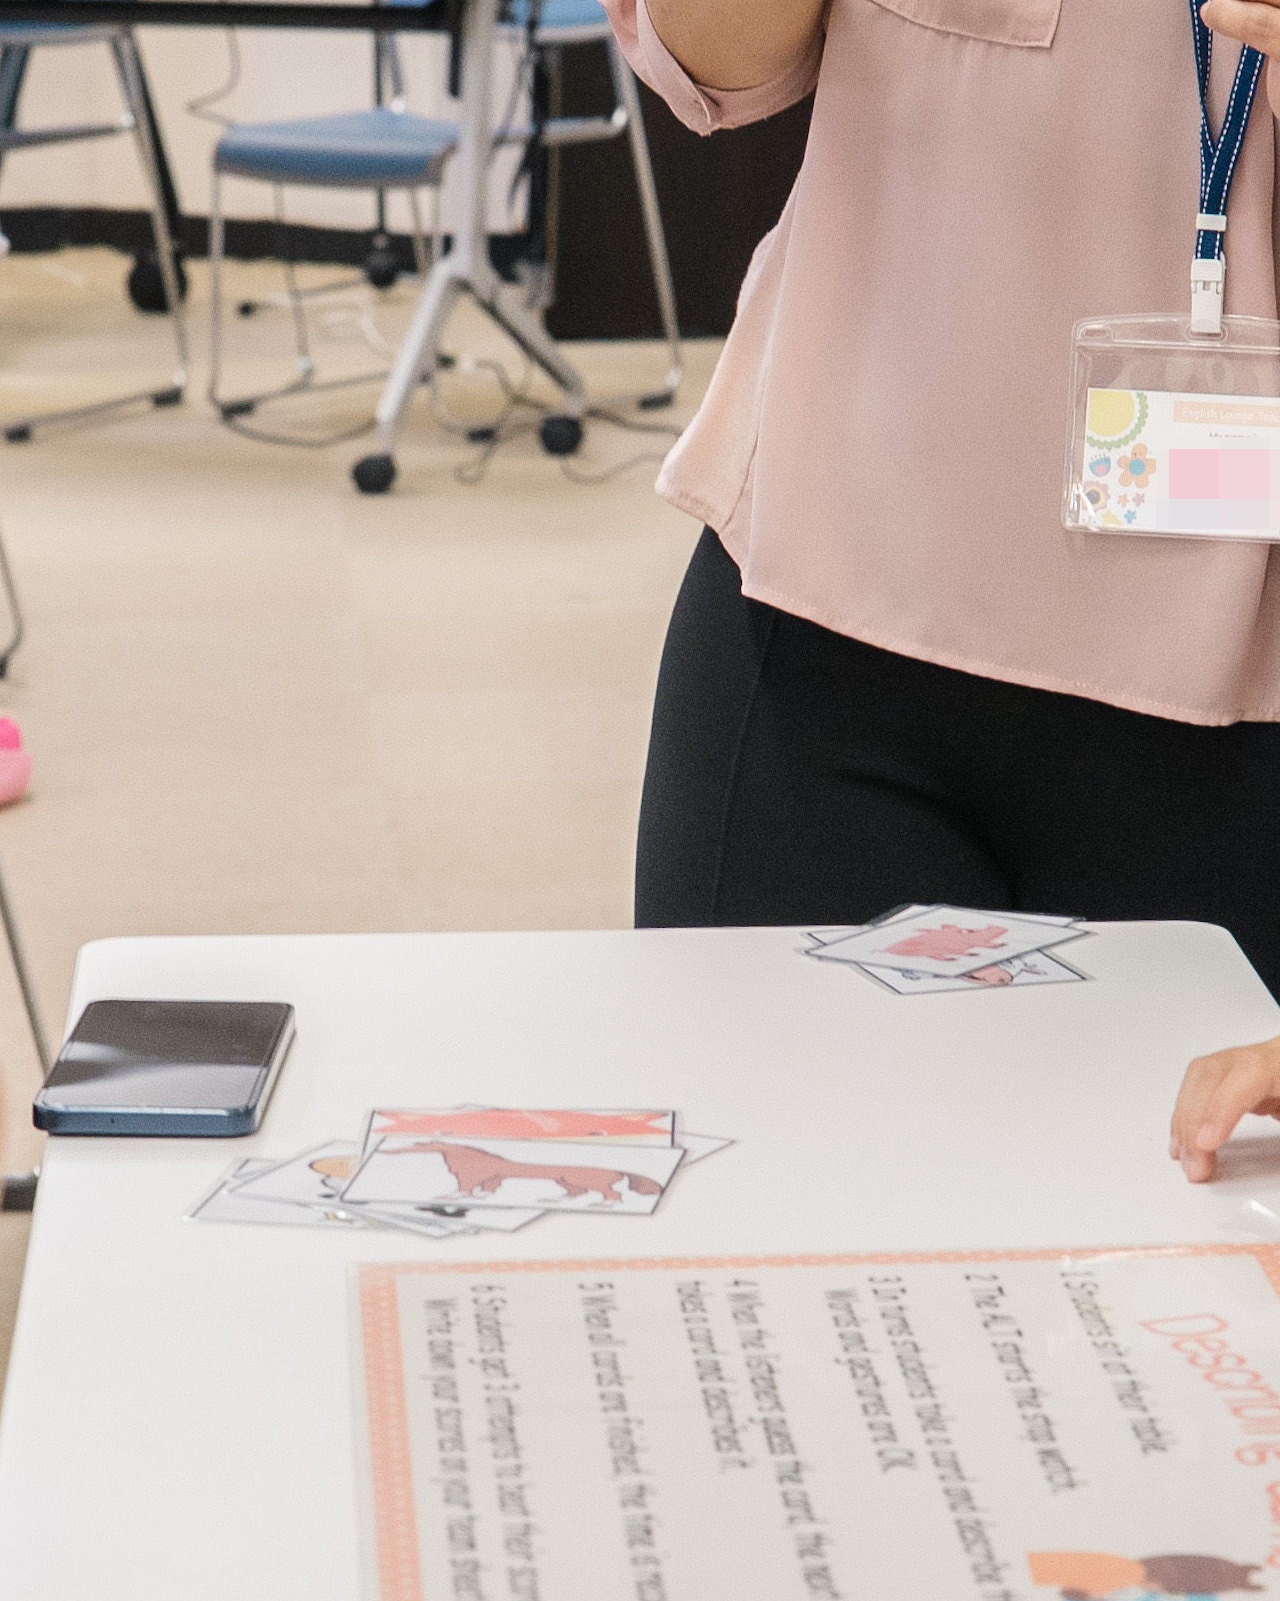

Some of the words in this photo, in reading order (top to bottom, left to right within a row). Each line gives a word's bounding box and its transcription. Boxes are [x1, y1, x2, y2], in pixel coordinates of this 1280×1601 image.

[1181, 406, 1217, 421] English
[1219, 409, 1254, 424] Lounge
[675, 1279, 712, 1315] takes
[726, 1290, 764, 1326] When
[824, 1288, 865, 1330] Words
[870, 1286, 908, 1302] In
[972, 1285, 1007, 1310] The
[1062, 1280, 1115, 1339] Students
[471, 1296, 510, 1355] Students
[581, 1293, 619, 1331] When
[878, 1303, 916, 1338] turns
[981, 1312, 1025, 1339] ALT
[586, 1331, 626, 1347] all
[685, 1326, 726, 1356] card
[738, 1327, 772, 1351] the
[836, 1330, 878, 1354] and
[1090, 1339, 1129, 1359] sit
[466, 1356, 514, 1381] get
[590, 1349, 632, 1389] cards
[693, 1358, 735, 1385] and
[889, 1339, 939, 1401] students
[990, 1340, 1035, 1384] starts
[1101, 1360, 1137, 1377] at
[744, 1353, 787, 1414] listeners
[833, 1355, 893, 1419] gestures
[1011, 1385, 1049, 1409] the
[1111, 1379, 1151, 1415] their
[598, 1392, 628, 1413] are
[913, 1401, 953, 1434] take
[480, 1394, 525, 1462] attempts
[700, 1386, 748, 1456] describes
[747, 1415, 798, 1457] guess
[867, 1421, 898, 1444] are
[1012, 1412, 1059, 1445] stop
[493, 1461, 527, 1481] to
[774, 1458, 811, 1486] the
[928, 1448, 977, 1484] card
[495, 1481, 534, 1518] beat
[618, 1481, 655, 1510] the
[941, 1485, 987, 1514] and
[502, 1521, 541, 1563] their
[623, 1513, 658, 1551] time
[794, 1530, 833, 1561] the
[629, 1552, 662, 1568] is
[952, 1517, 1011, 1586] describe
[802, 1563, 843, 1601] next
